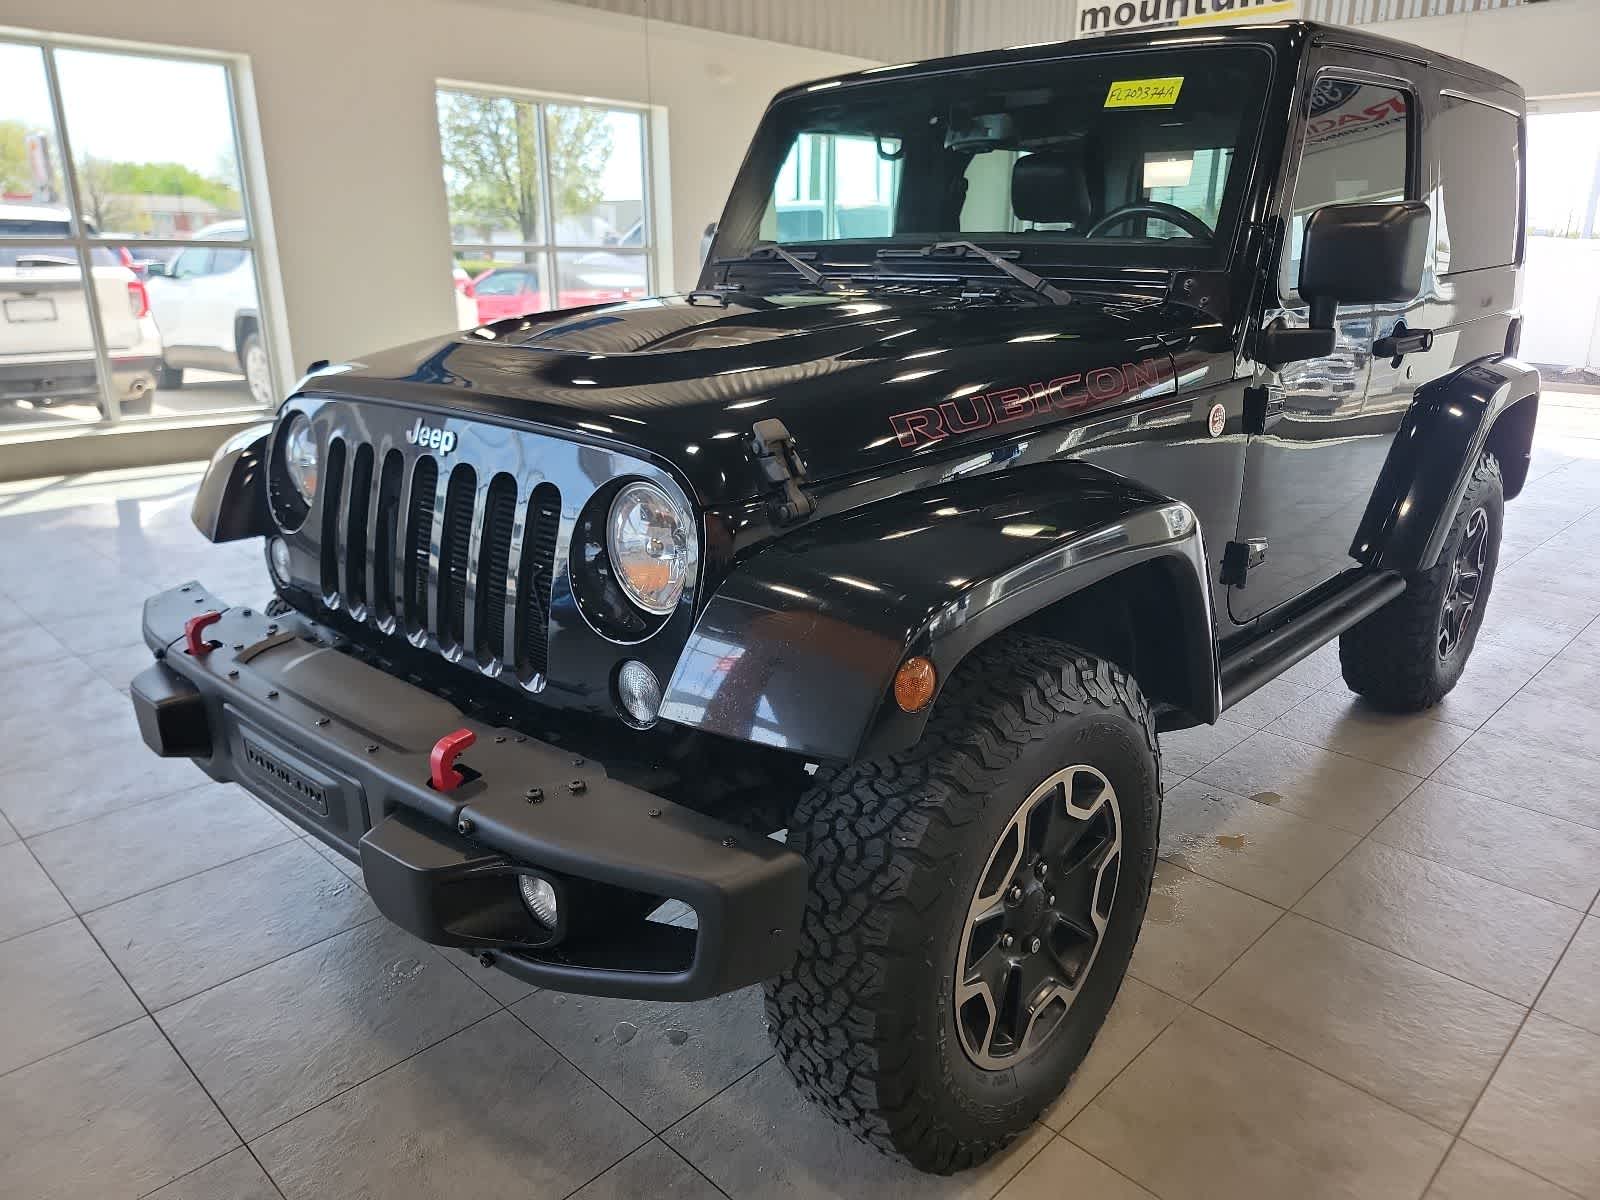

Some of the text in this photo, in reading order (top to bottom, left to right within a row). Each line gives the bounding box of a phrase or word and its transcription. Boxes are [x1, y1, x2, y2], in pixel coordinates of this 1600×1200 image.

[1081, 0, 1288, 32] mountu
[888, 358, 1161, 447] RUBICON
[406, 416, 457, 457] Jeep
